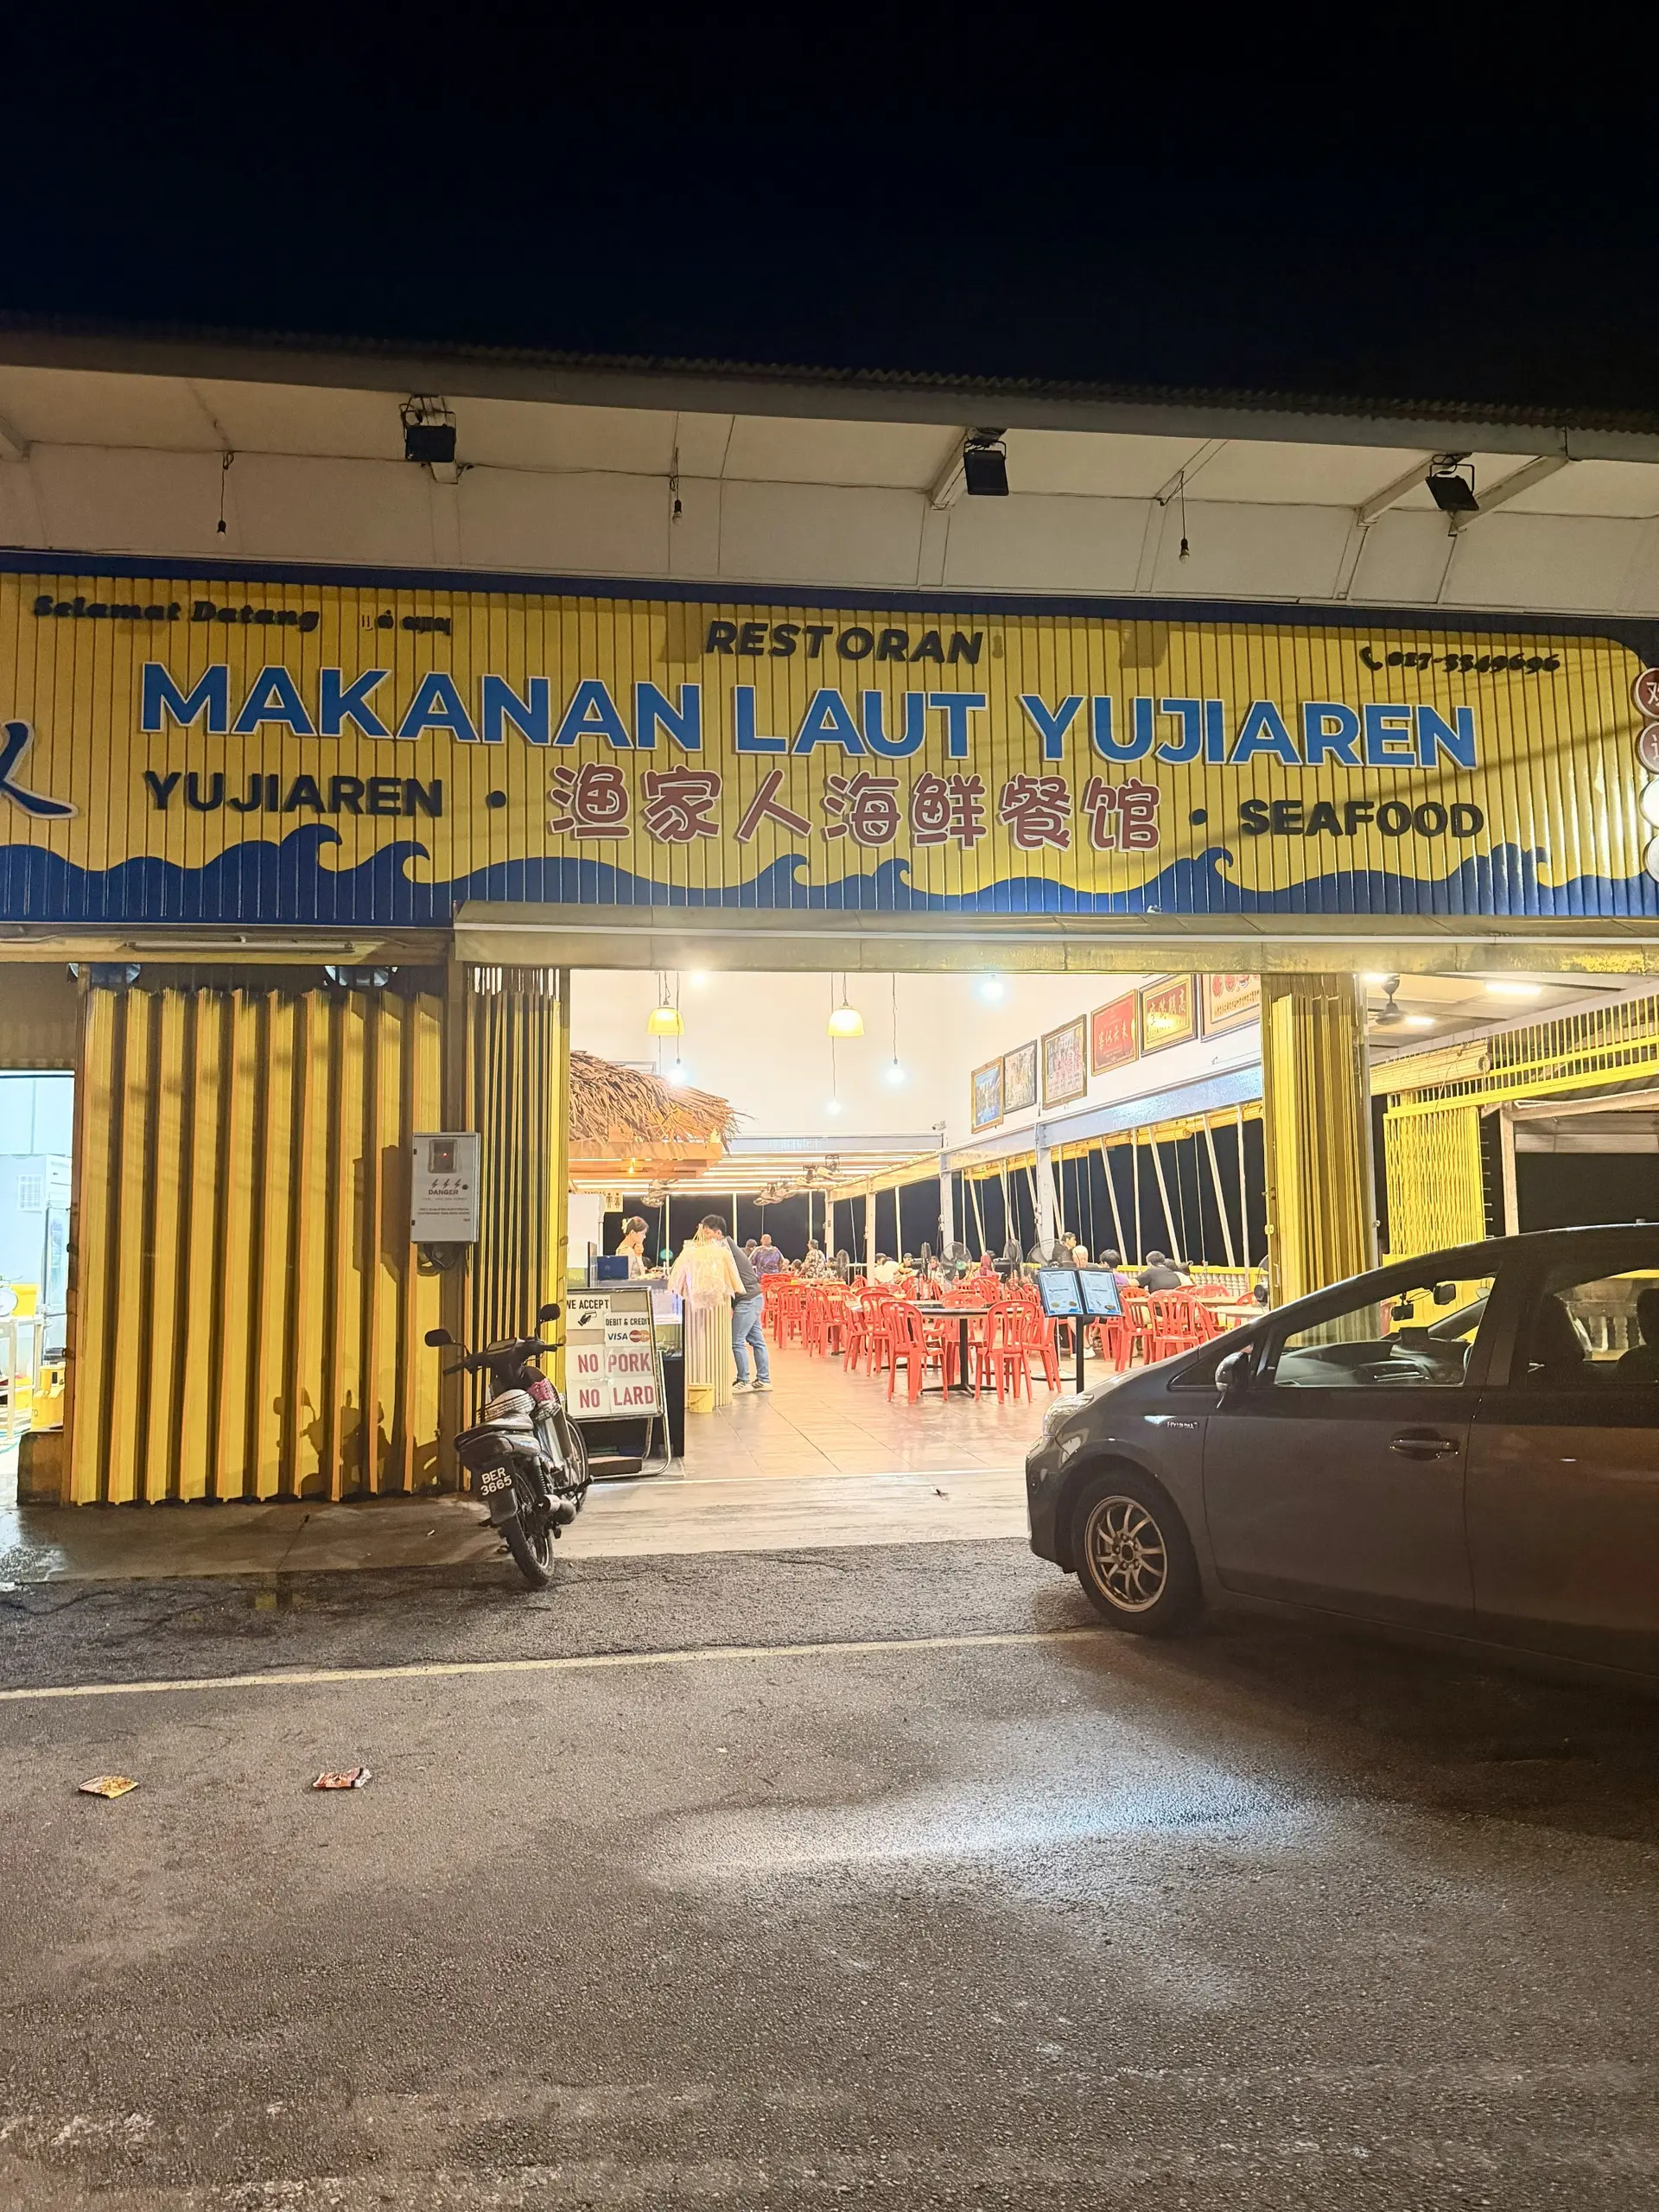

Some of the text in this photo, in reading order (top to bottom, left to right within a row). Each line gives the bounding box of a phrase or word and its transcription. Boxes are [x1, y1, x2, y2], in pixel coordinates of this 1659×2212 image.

[35, 594, 320, 632] Selamat Datang
[705, 620, 983, 664] RESTORAN
[140, 661, 1477, 771] MAKANAN LAUT YUJIAREN
[143, 770, 442, 817] YUJIAREN
[549, 761, 1160, 852] 渔家人海鲜餐馆
[1240, 798, 1484, 839] SEAFOOD
[579, 1300, 609, 1309] ACCEPT
[606, 1318, 622, 1326] DEBIT
[630, 1317, 650, 1325] CREDIT
[578, 1352, 651, 1373] NO PORK
[579, 1385, 654, 1408] NO LARD
[480, 1475, 512, 1496] 3665
[481, 1467, 506, 1484] BER
